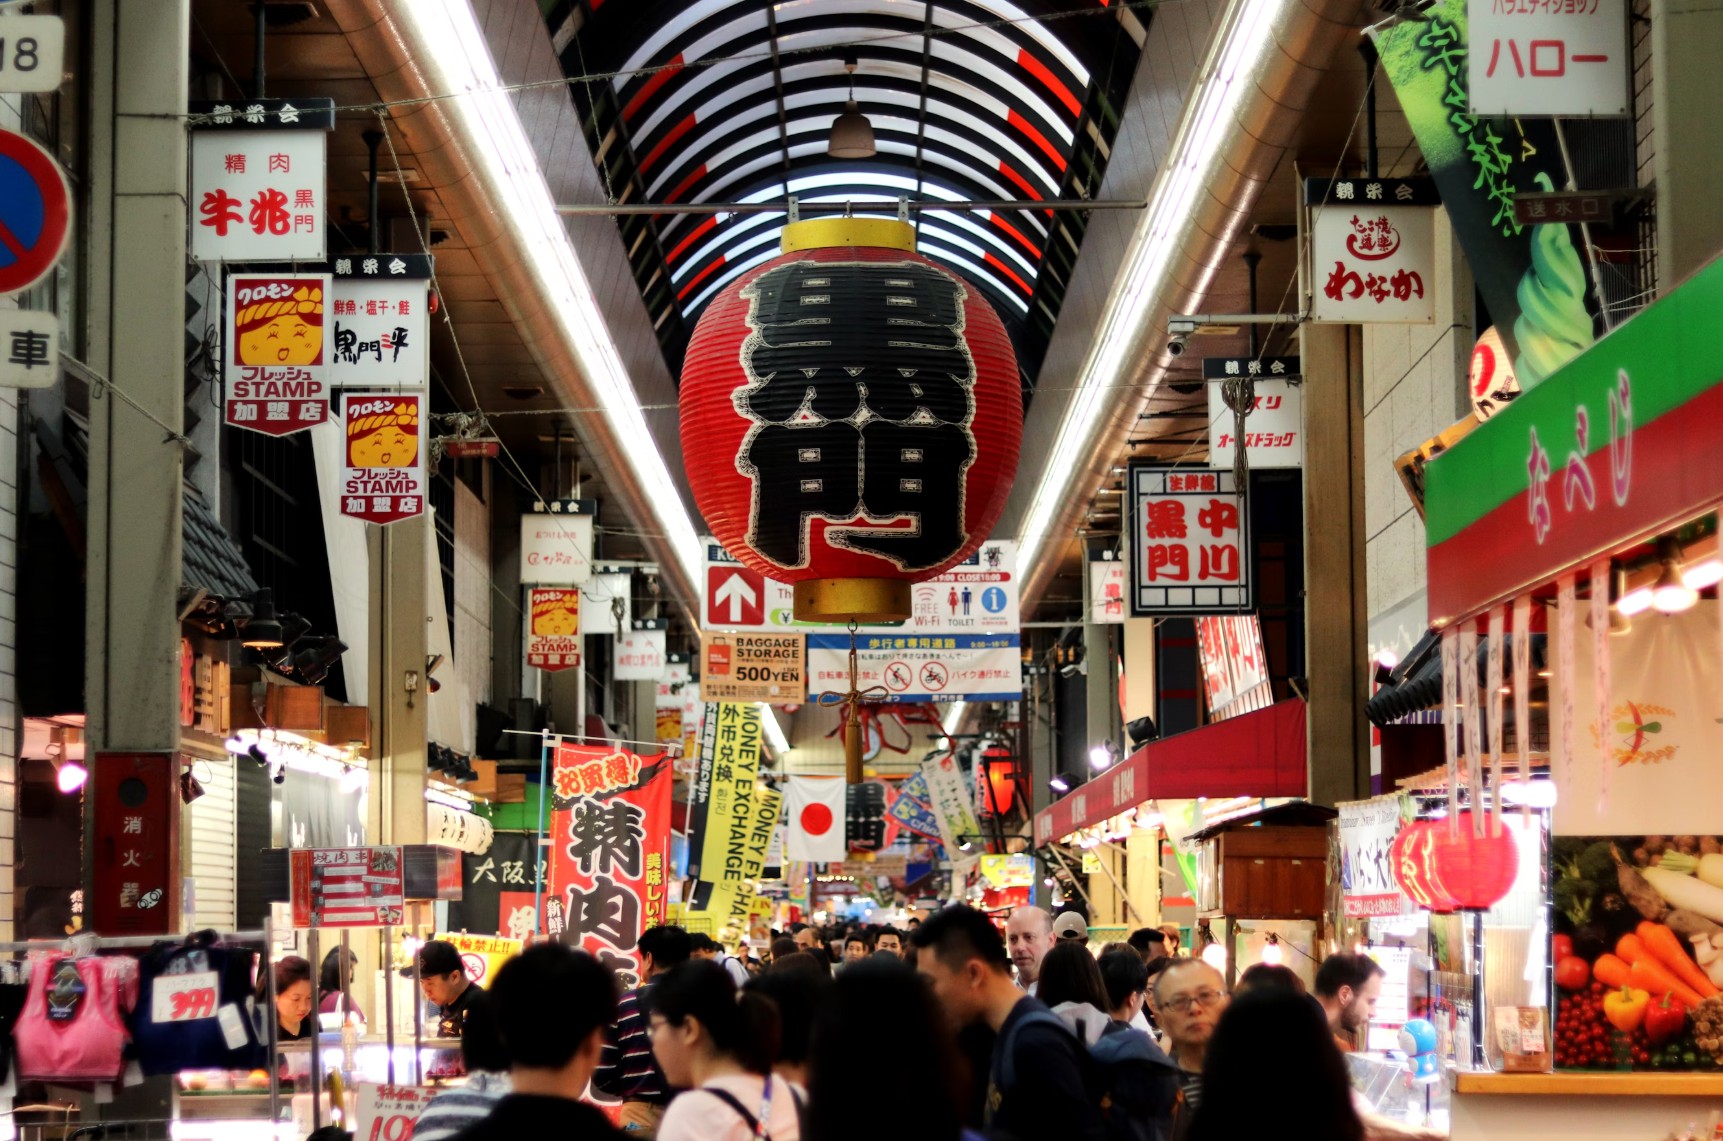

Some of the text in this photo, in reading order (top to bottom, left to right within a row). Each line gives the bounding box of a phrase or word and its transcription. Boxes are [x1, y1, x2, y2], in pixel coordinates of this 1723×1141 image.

[1487, 39, 1608, 78] ハロー
[225, 153, 291, 174] 精肉
[1336, 182, 1414, 200] 親栄会
[293, 189, 314, 233] 黒門
[1526, 200, 1599, 217] 送水口
[335, 258, 407, 275] 親栄会
[1323, 261, 1424, 304] わなか
[238, 283, 294, 305] クロモン
[8, 330, 50, 370] 車
[241, 367, 313, 381] フレッシュ
[233, 381, 323, 398] STAMP
[233, 402, 322, 421] 加盟店
[348, 401, 394, 418] クロモン
[730, 258, 978, 574] 黒門
[1217, 432, 1296, 448] オースドラッグ
[352, 469, 410, 480] フレッシュ
[346, 480, 418, 494] STAMP
[346, 497, 418, 513] 加盟店
[1146, 499, 1190, 582] 黒門
[1197, 499, 1239, 581] 中川
[914, 603, 939, 614] FREE
[914, 615, 940, 626] Wi-Fi
[531, 644, 577, 652] STAMP
[736, 638, 799, 648] BAGGAGE
[736, 649, 799, 659] STORAGE
[738, 706, 760, 772] MONEY
[723, 779, 752, 881] EXCHANGE
[749, 794, 779, 858] MONEY
[170, 988, 215, 1020] 399
[369, 1115, 420, 1141] 10
